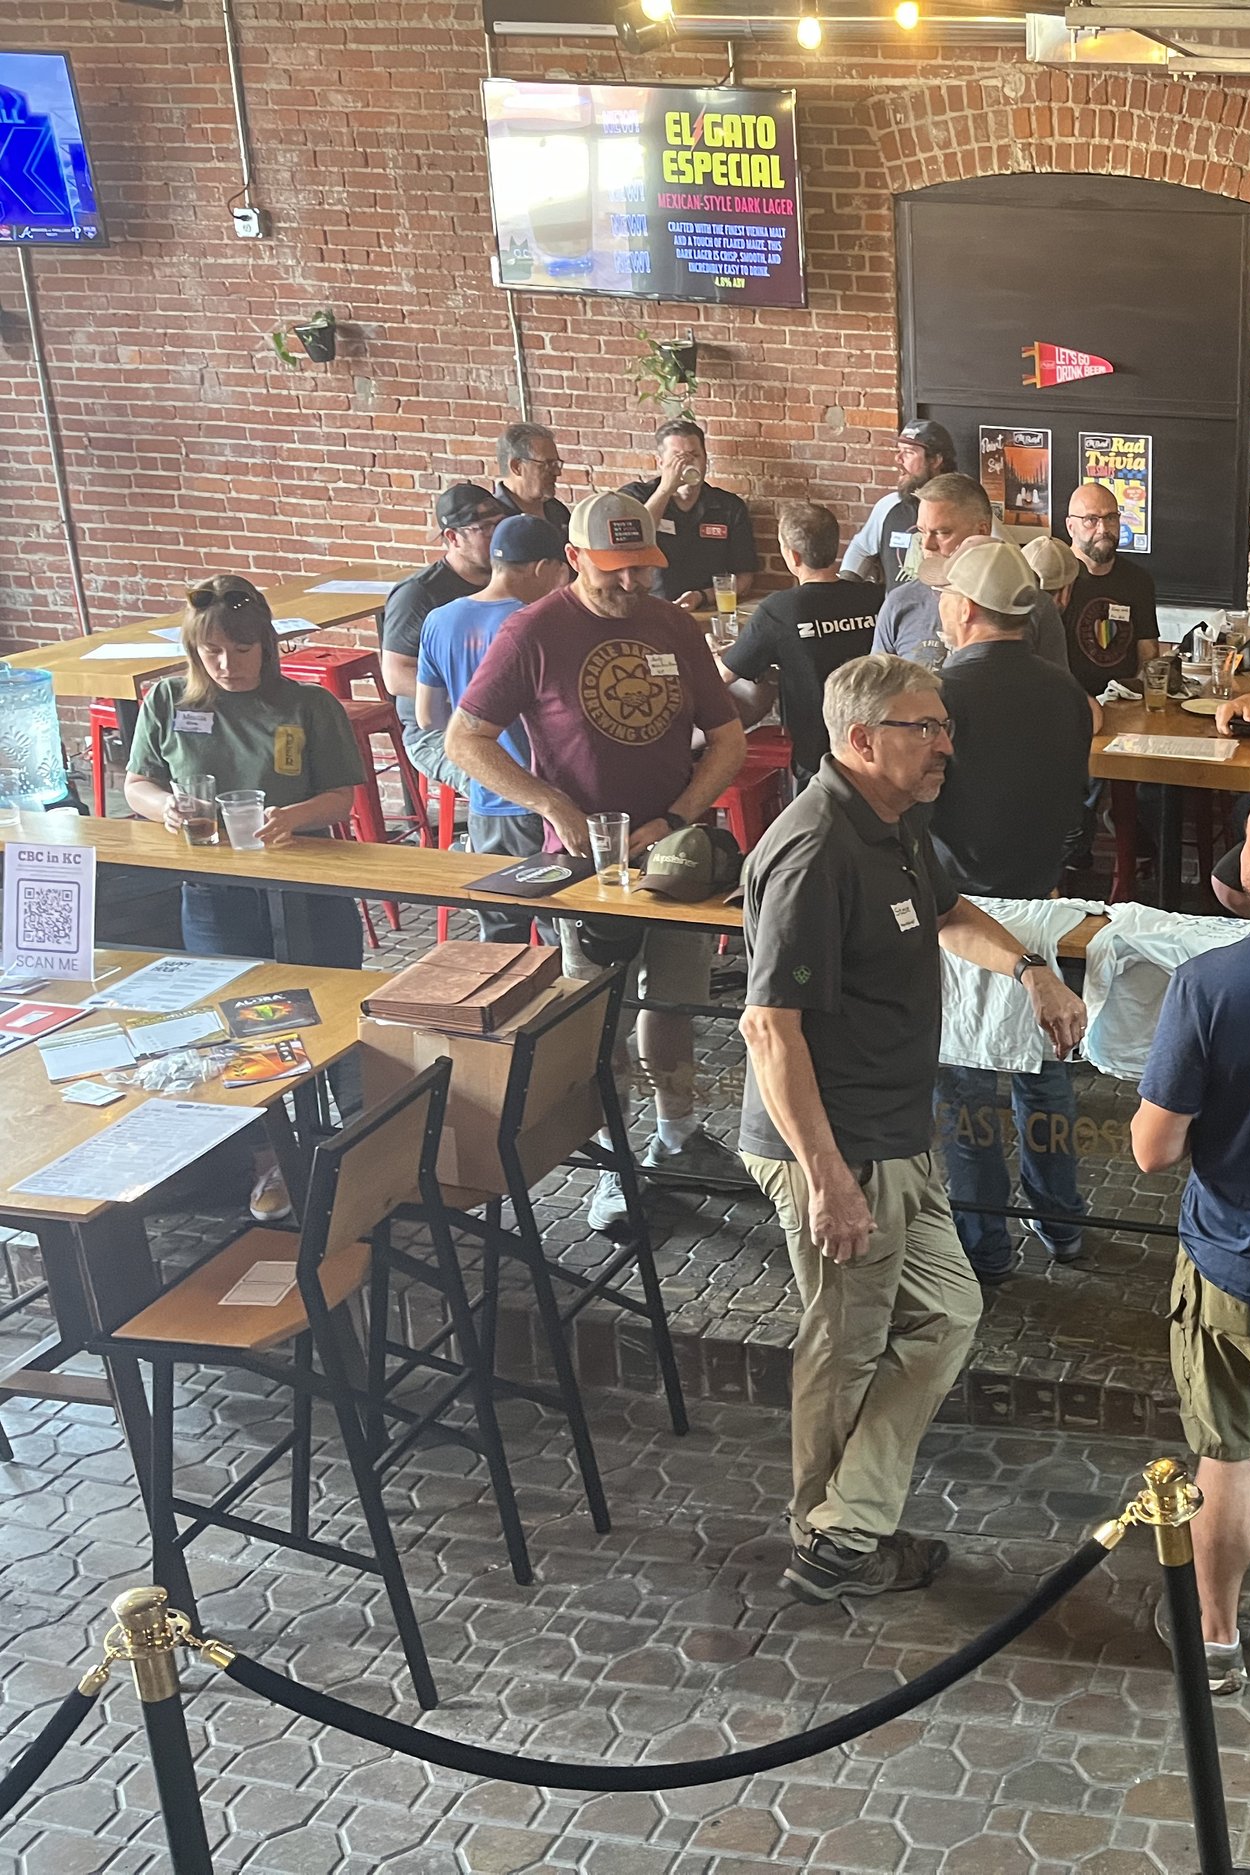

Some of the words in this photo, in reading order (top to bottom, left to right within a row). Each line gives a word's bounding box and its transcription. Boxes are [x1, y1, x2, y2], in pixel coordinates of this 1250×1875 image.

[665, 112, 695, 146] EL
[703, 113, 776, 149] GATO
[662, 150, 785, 188] ESPECIAL
[658, 193, 732, 212] MEXICAN-STYLE
[735, 196, 760, 213] DARK
[763, 198, 793, 215] LAGER
[668, 221, 694, 233] CRAFTED
[674, 235, 687, 246] AND
[693, 249, 712, 260] LAGER
[1055, 346, 1077, 365] LET'S
[1077, 352, 1090, 366] GO
[1056, 365, 1084, 383] DRINK
[1111, 437, 1145, 454] Rad
[1085, 451, 1146, 471] Trivia
[587, 645, 619, 677] ABLE
[583, 689, 637, 741] BREWING
[17, 850, 44, 862] CBC
[47, 851, 59, 863] in
[62, 853, 82, 865] KC
[16, 955, 54, 969] SCAN
[58, 958, 79, 972] ME
